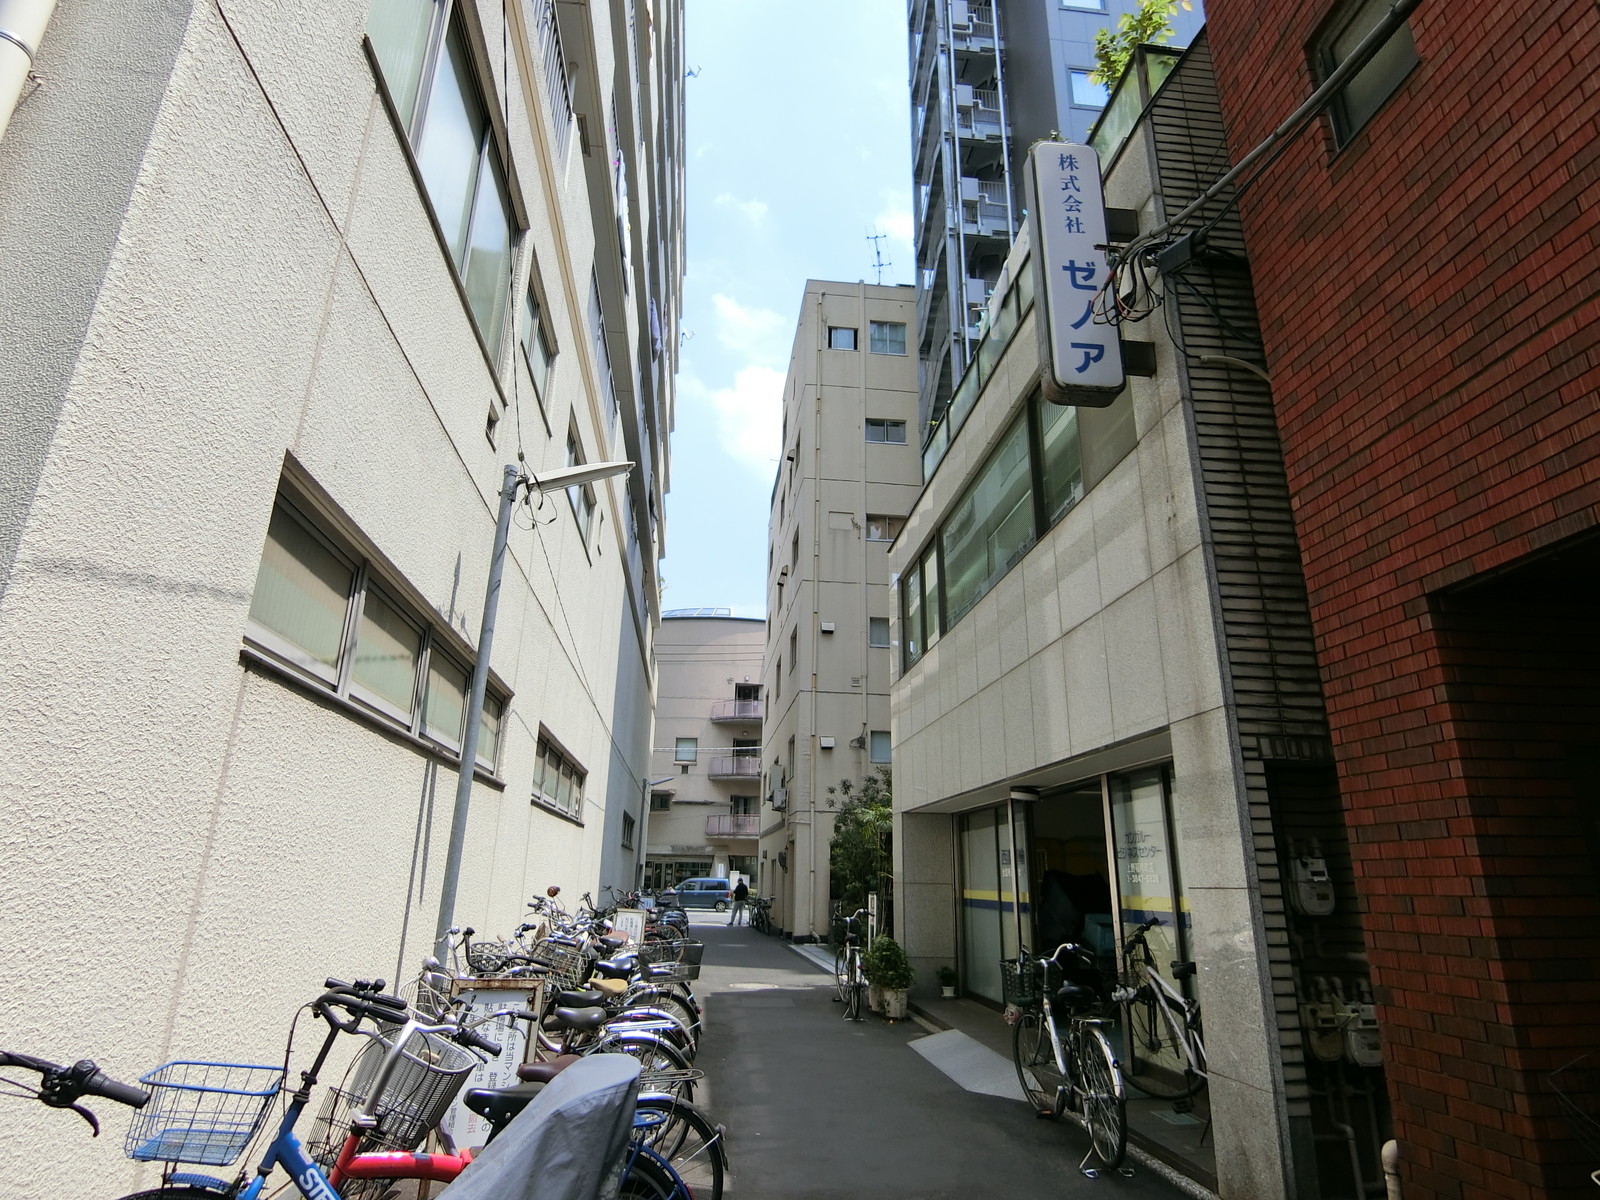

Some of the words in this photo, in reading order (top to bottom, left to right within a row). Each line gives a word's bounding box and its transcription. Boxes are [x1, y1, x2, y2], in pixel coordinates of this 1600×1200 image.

[1058, 153, 1086, 234] 株式会社
[1062, 259, 1105, 374] ゼノア
